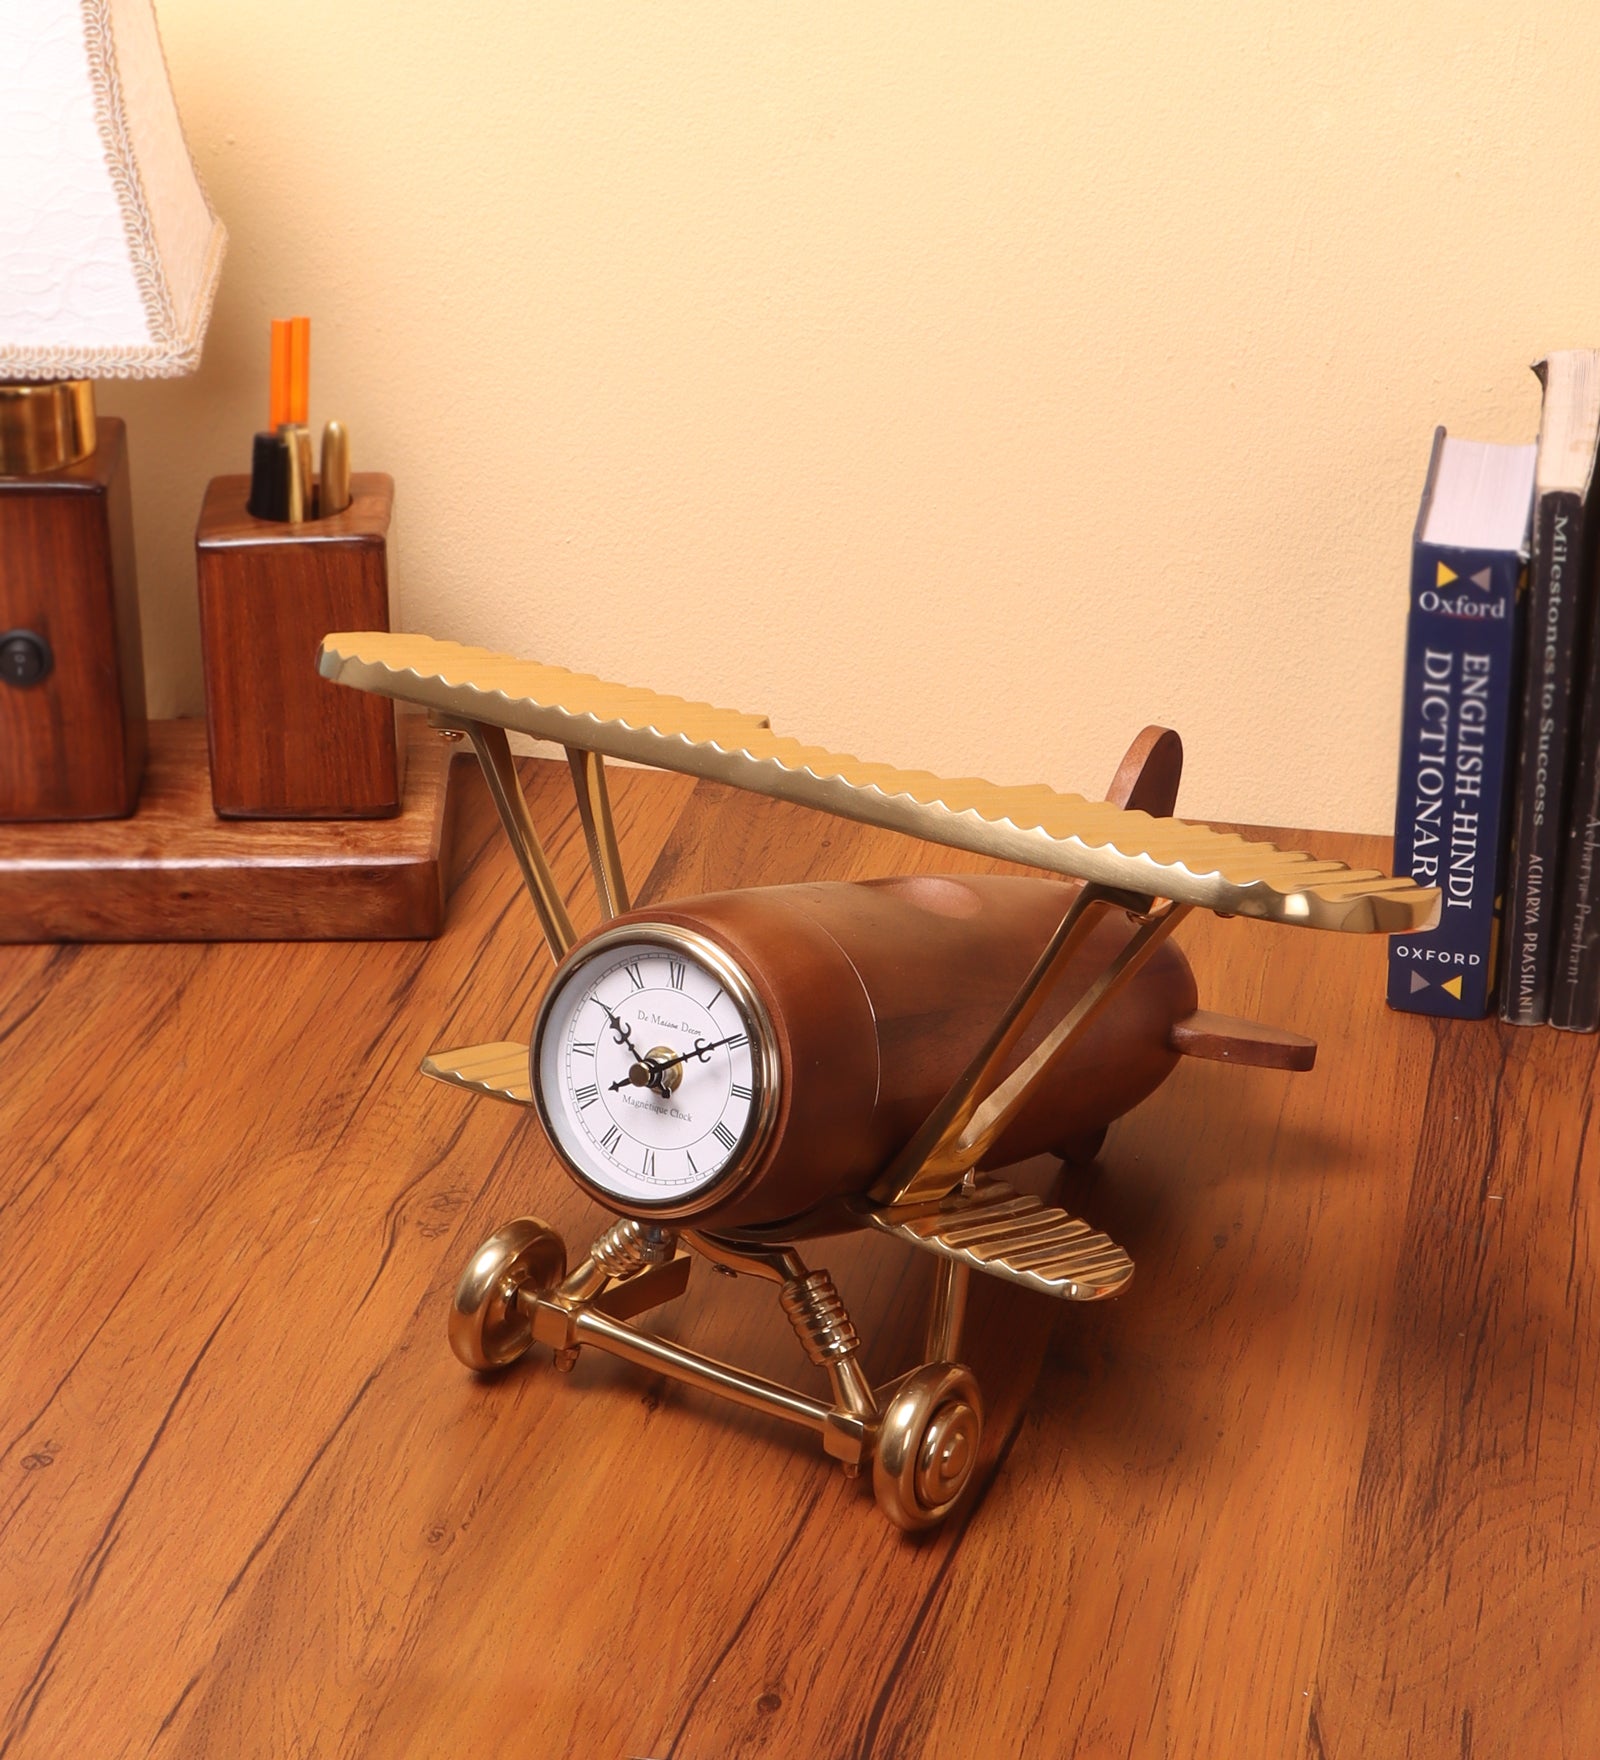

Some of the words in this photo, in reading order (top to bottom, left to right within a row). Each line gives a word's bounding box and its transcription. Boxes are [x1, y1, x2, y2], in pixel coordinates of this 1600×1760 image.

[1419, 591, 1506, 619] Oxford
[1546, 515, 1569, 675] Milestones
[1541, 683, 1556, 710] to
[1411, 648, 1453, 888] DICTIONAR
[1447, 653, 1490, 909] ENGLISH-HINDI
[1533, 718, 1555, 826] Success
[1524, 853, 1543, 925] ACHARYA
[1396, 945, 1481, 966] OXFORD
[1518, 932, 1538, 1014] PRASHANT
[1566, 902, 1592, 984] Prashant
[637, 1009, 649, 1022] De
[669, 1108, 693, 1122] Clock
